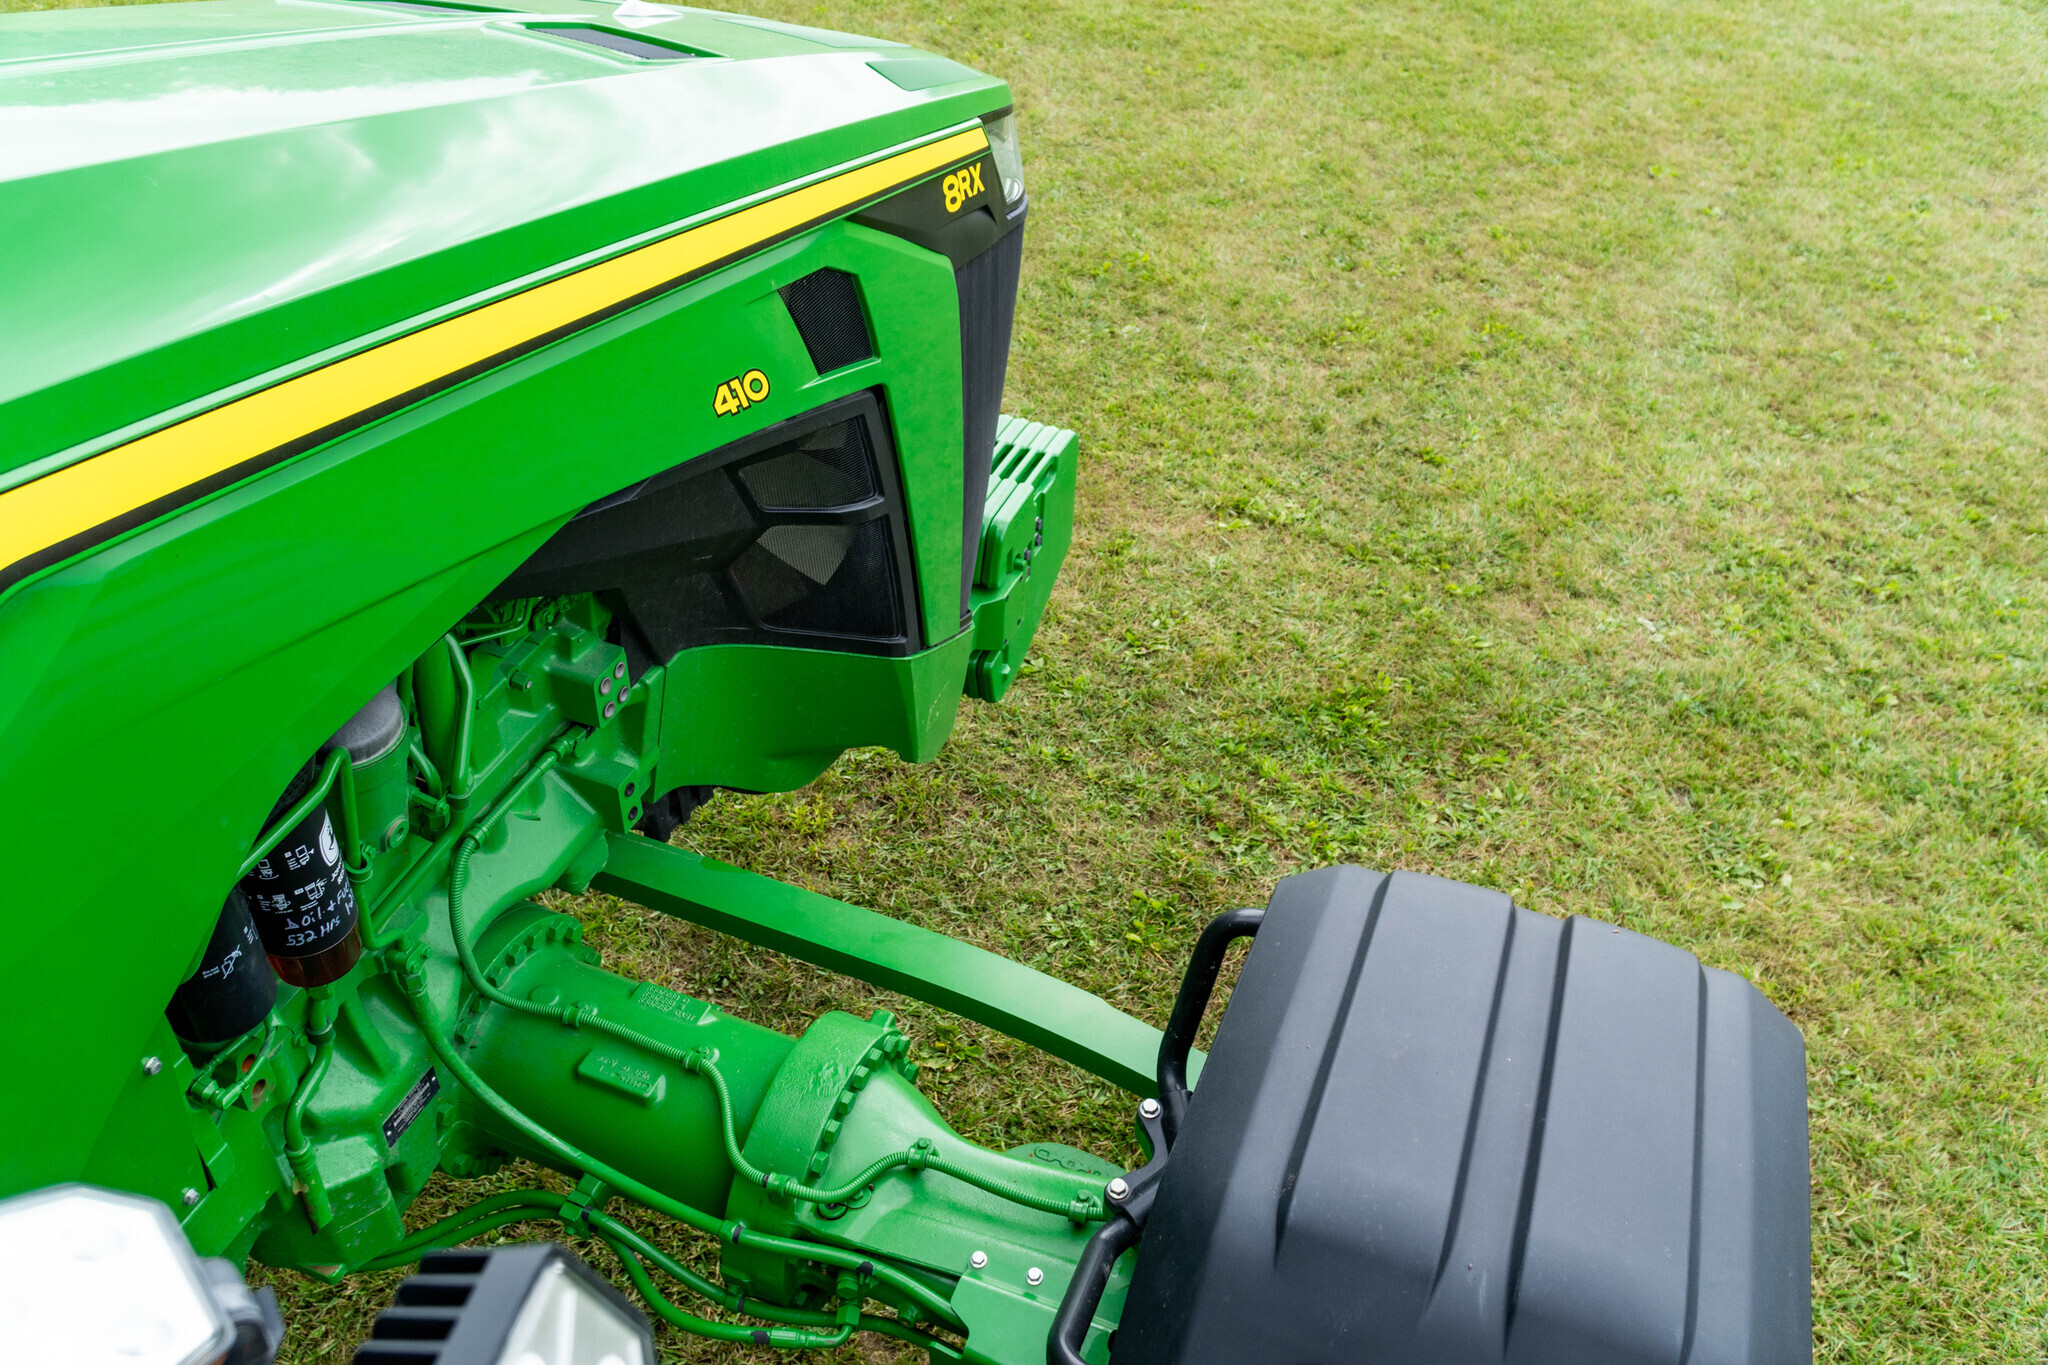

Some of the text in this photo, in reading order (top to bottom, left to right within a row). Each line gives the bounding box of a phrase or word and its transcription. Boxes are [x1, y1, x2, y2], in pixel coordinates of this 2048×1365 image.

[943, 162, 985, 213] 8RX
[712, 368, 770, 418] 410
[286, 930, 318, 946] 532
